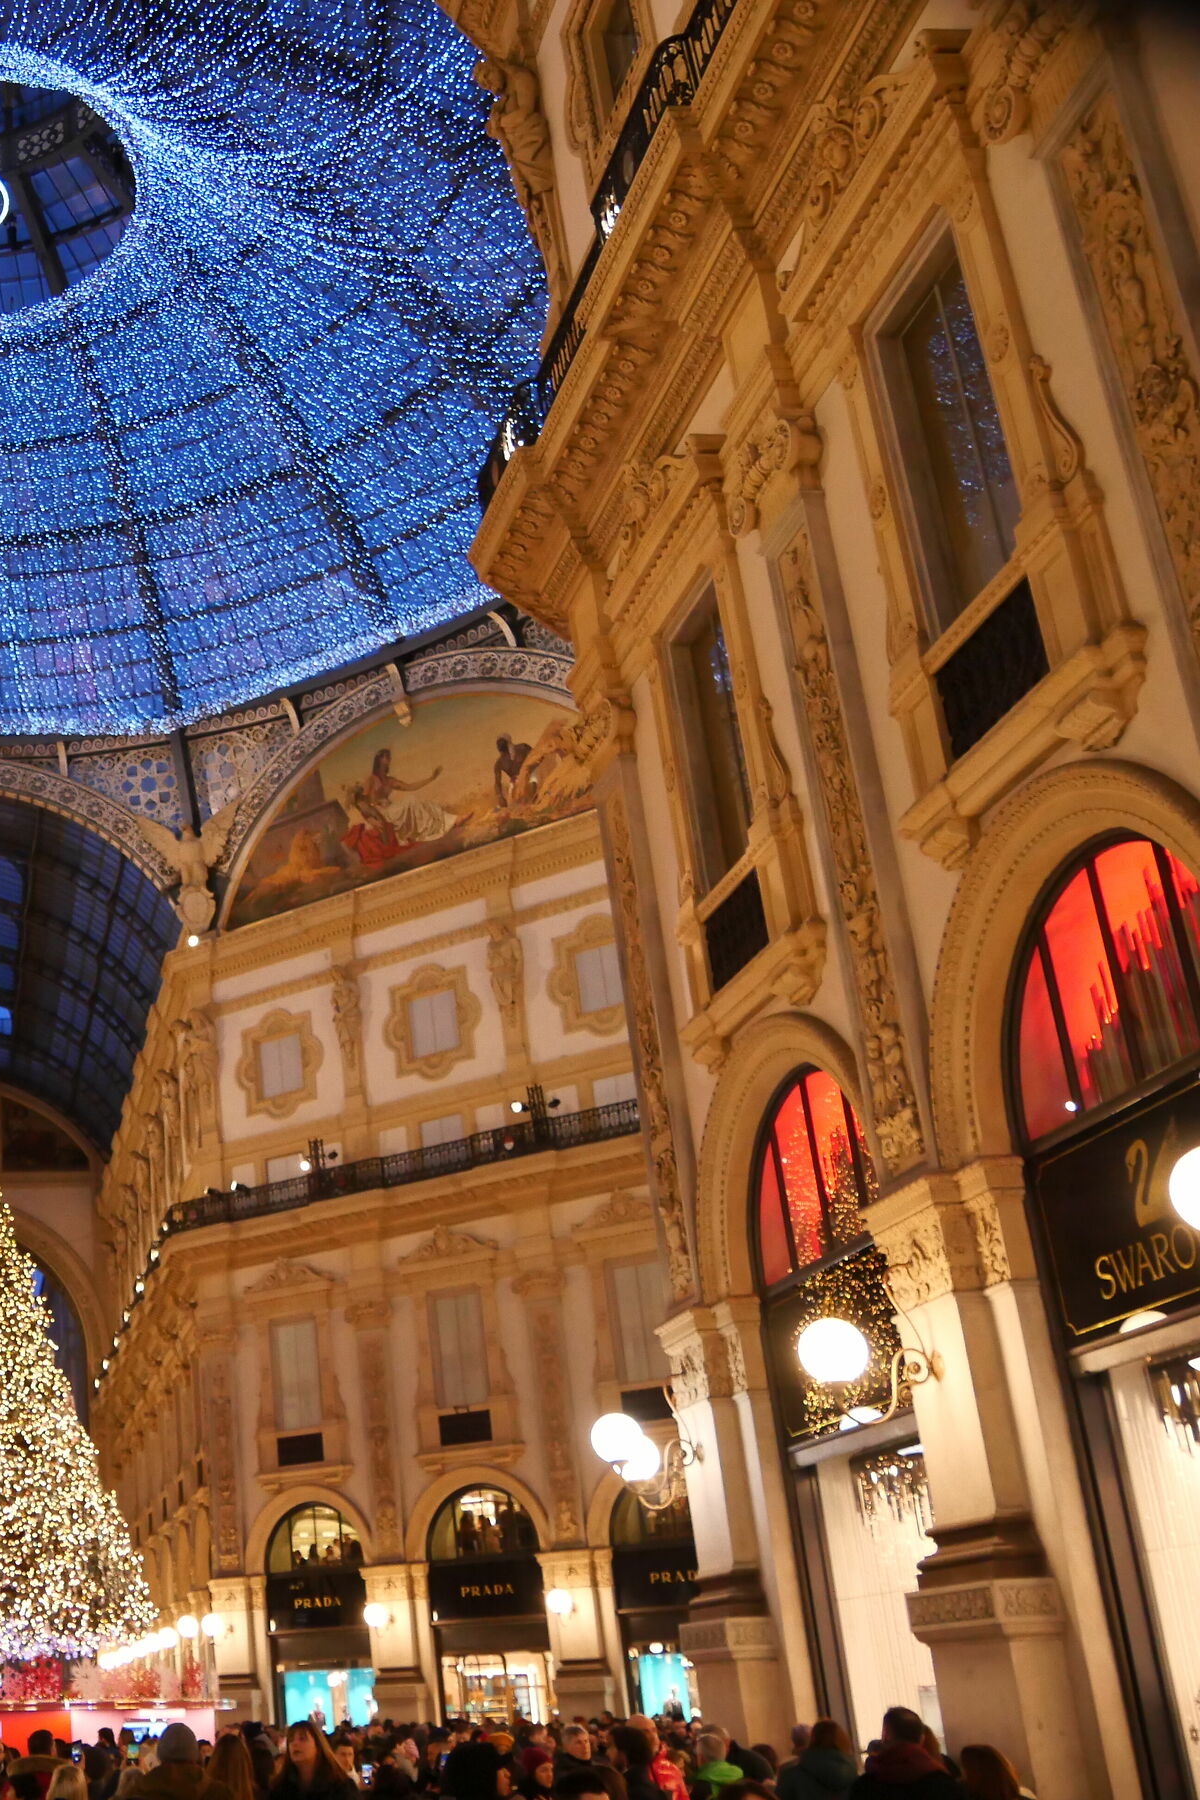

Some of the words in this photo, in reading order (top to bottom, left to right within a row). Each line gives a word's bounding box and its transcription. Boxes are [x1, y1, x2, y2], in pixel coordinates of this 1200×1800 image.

[1094, 1223, 1197, 1300] SWARO
[460, 1583, 514, 1598] PRADA
[294, 1595, 342, 1609] PRADA
